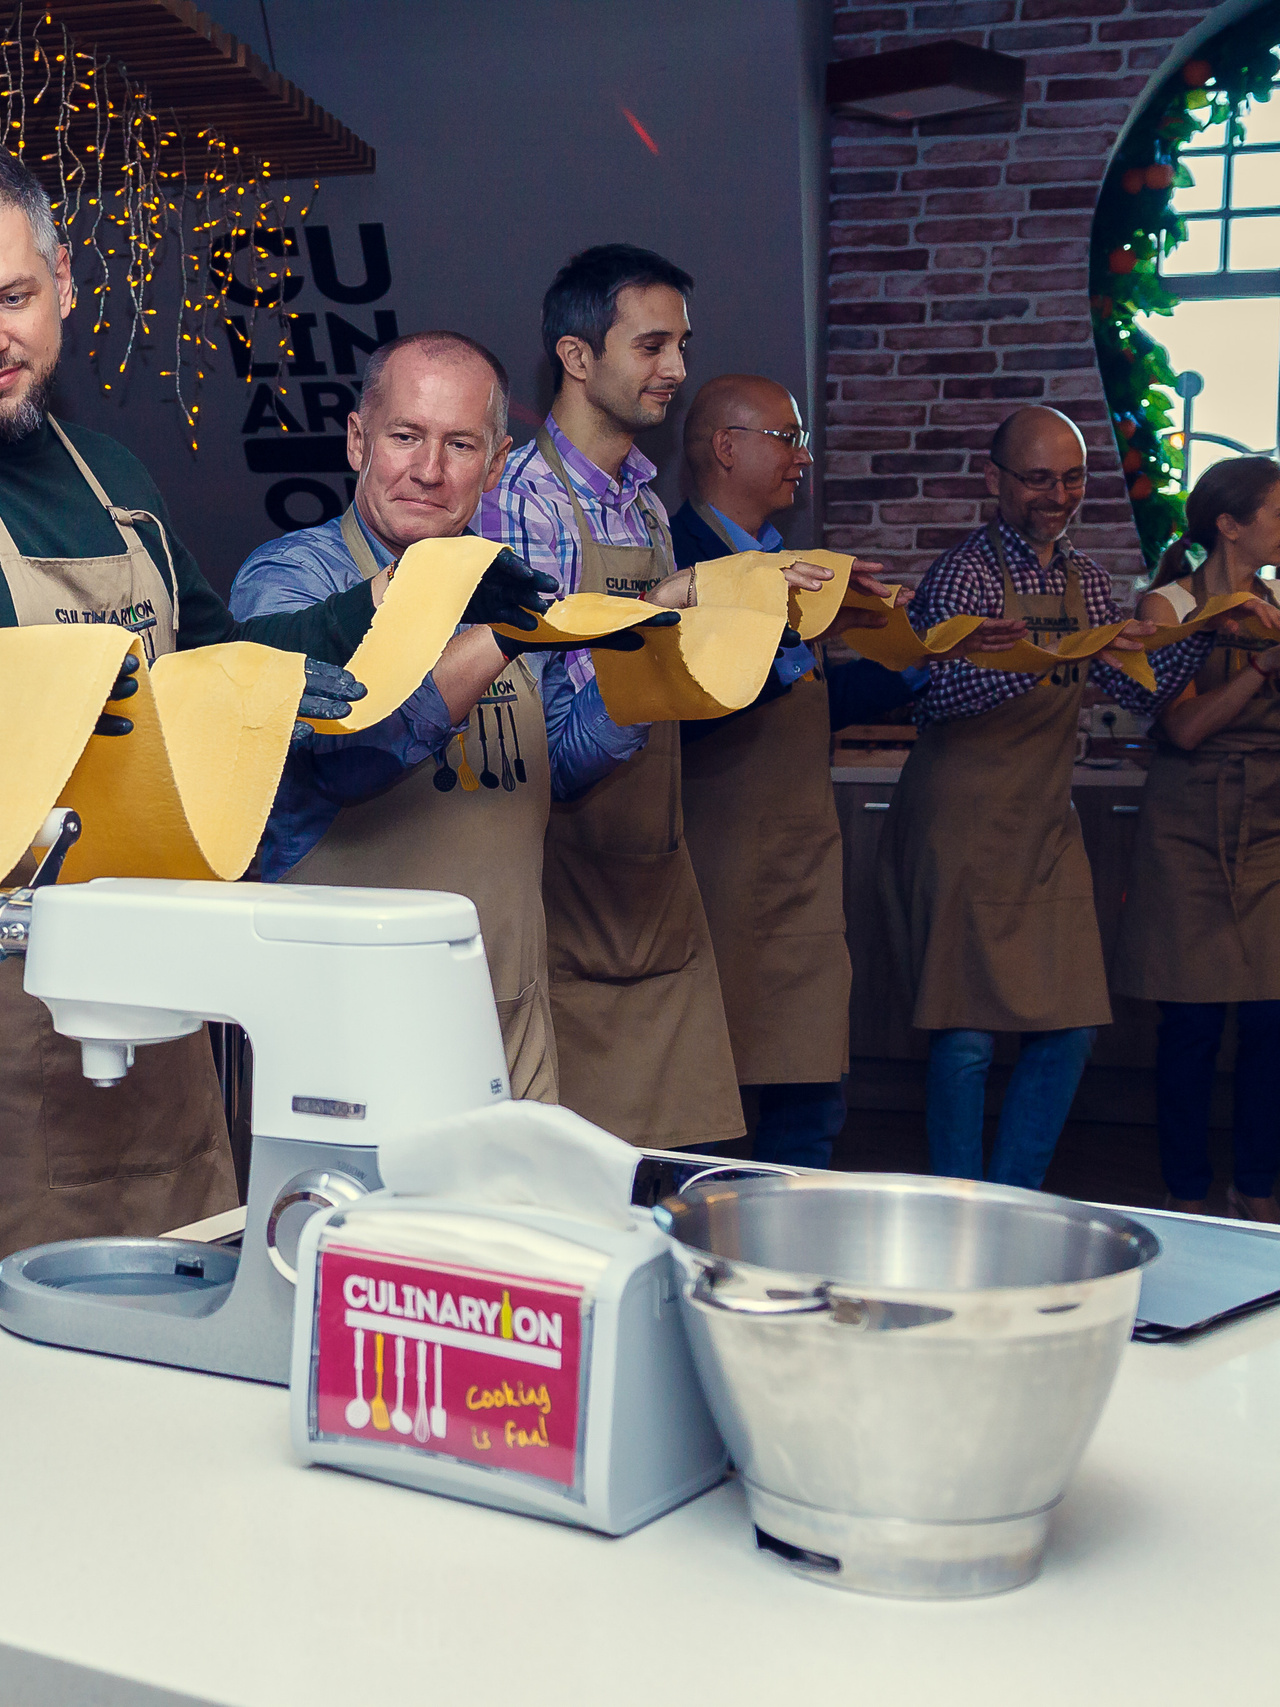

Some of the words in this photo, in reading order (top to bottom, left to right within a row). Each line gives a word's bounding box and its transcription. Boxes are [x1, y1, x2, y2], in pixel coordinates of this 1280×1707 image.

[210, 222, 392, 308] CU
[241, 380, 370, 434] AR
[465, 1380, 552, 1415] Cooking
